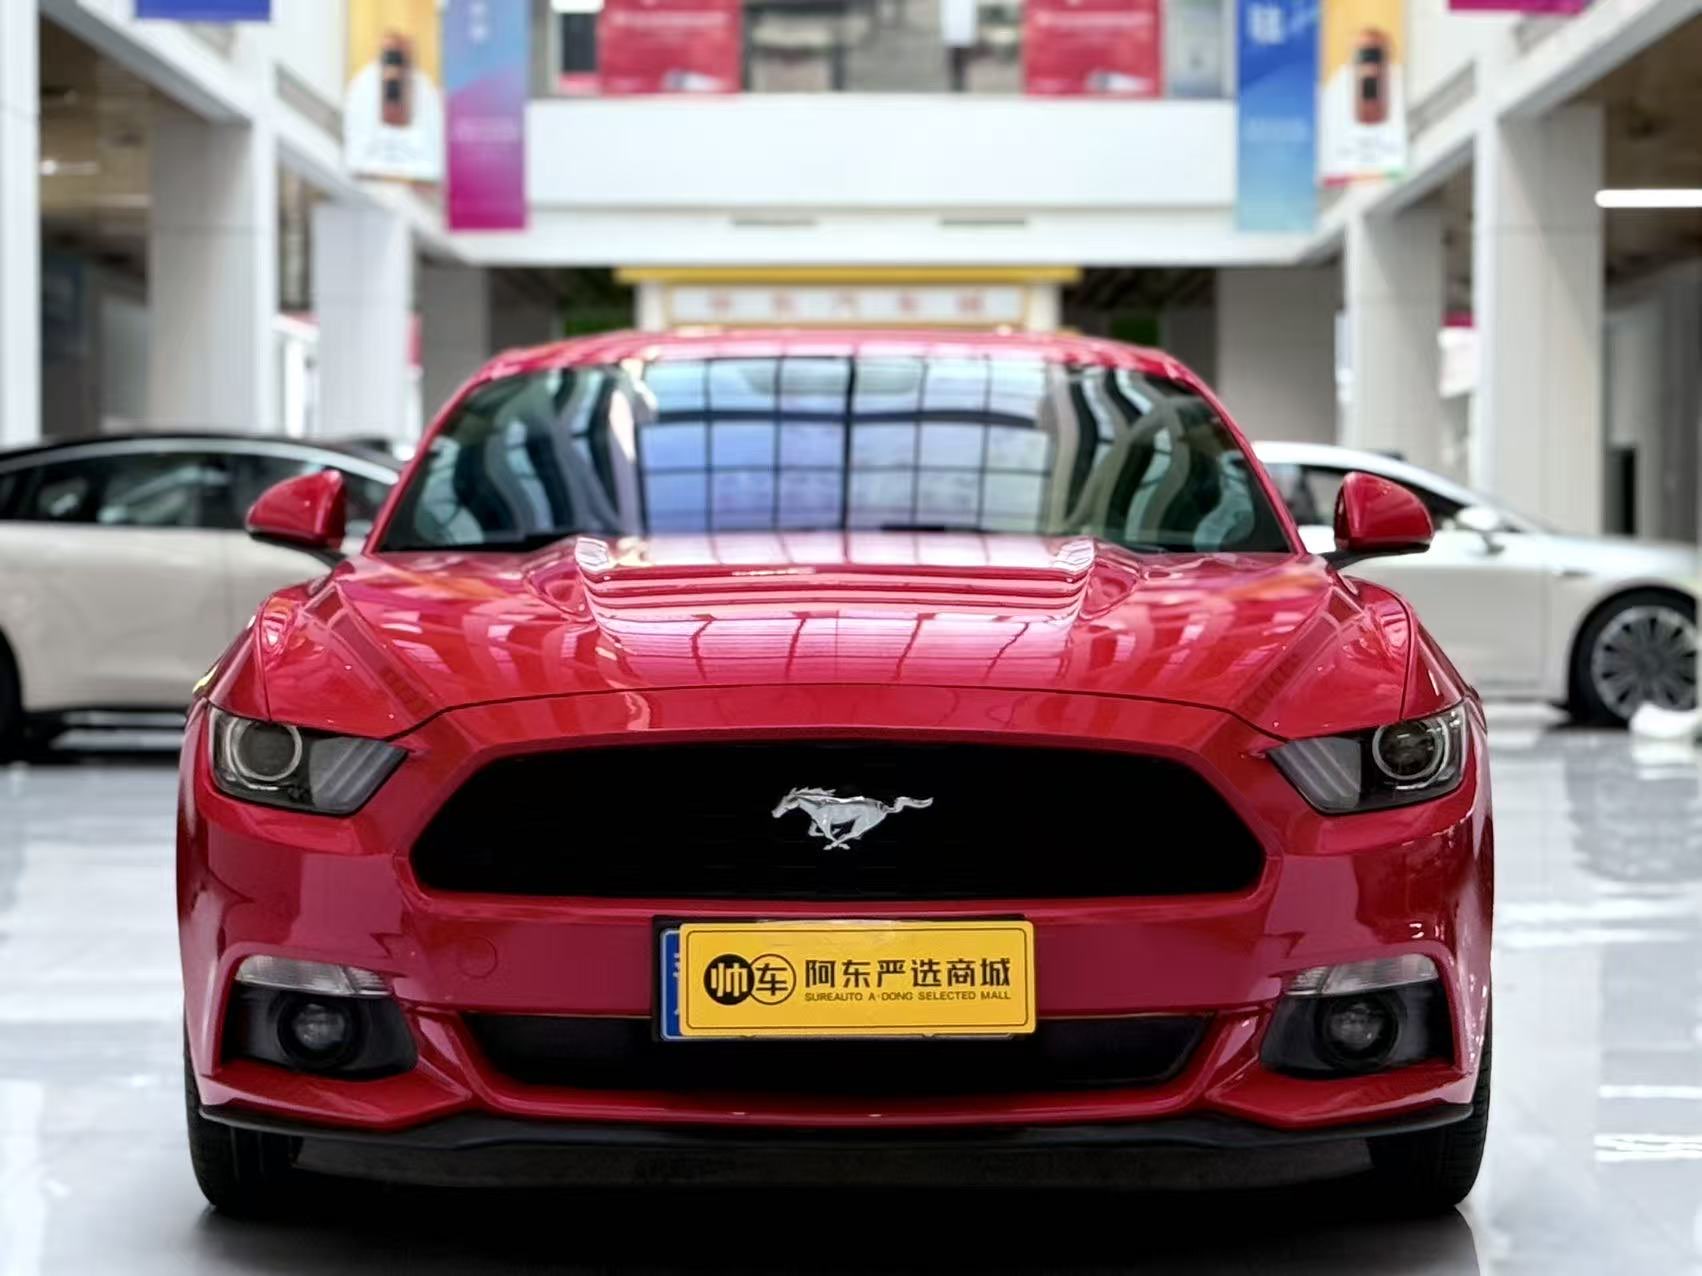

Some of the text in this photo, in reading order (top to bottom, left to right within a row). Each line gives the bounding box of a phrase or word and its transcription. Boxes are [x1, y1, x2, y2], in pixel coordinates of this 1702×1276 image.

[709, 961, 789, 998] 帅车
[804, 957, 1011, 989] 阿东严选商城
[804, 992, 863, 1002] SUREAUTO
[917, 991, 976, 1001] SELECTED
[980, 990, 1011, 1000] MALL
